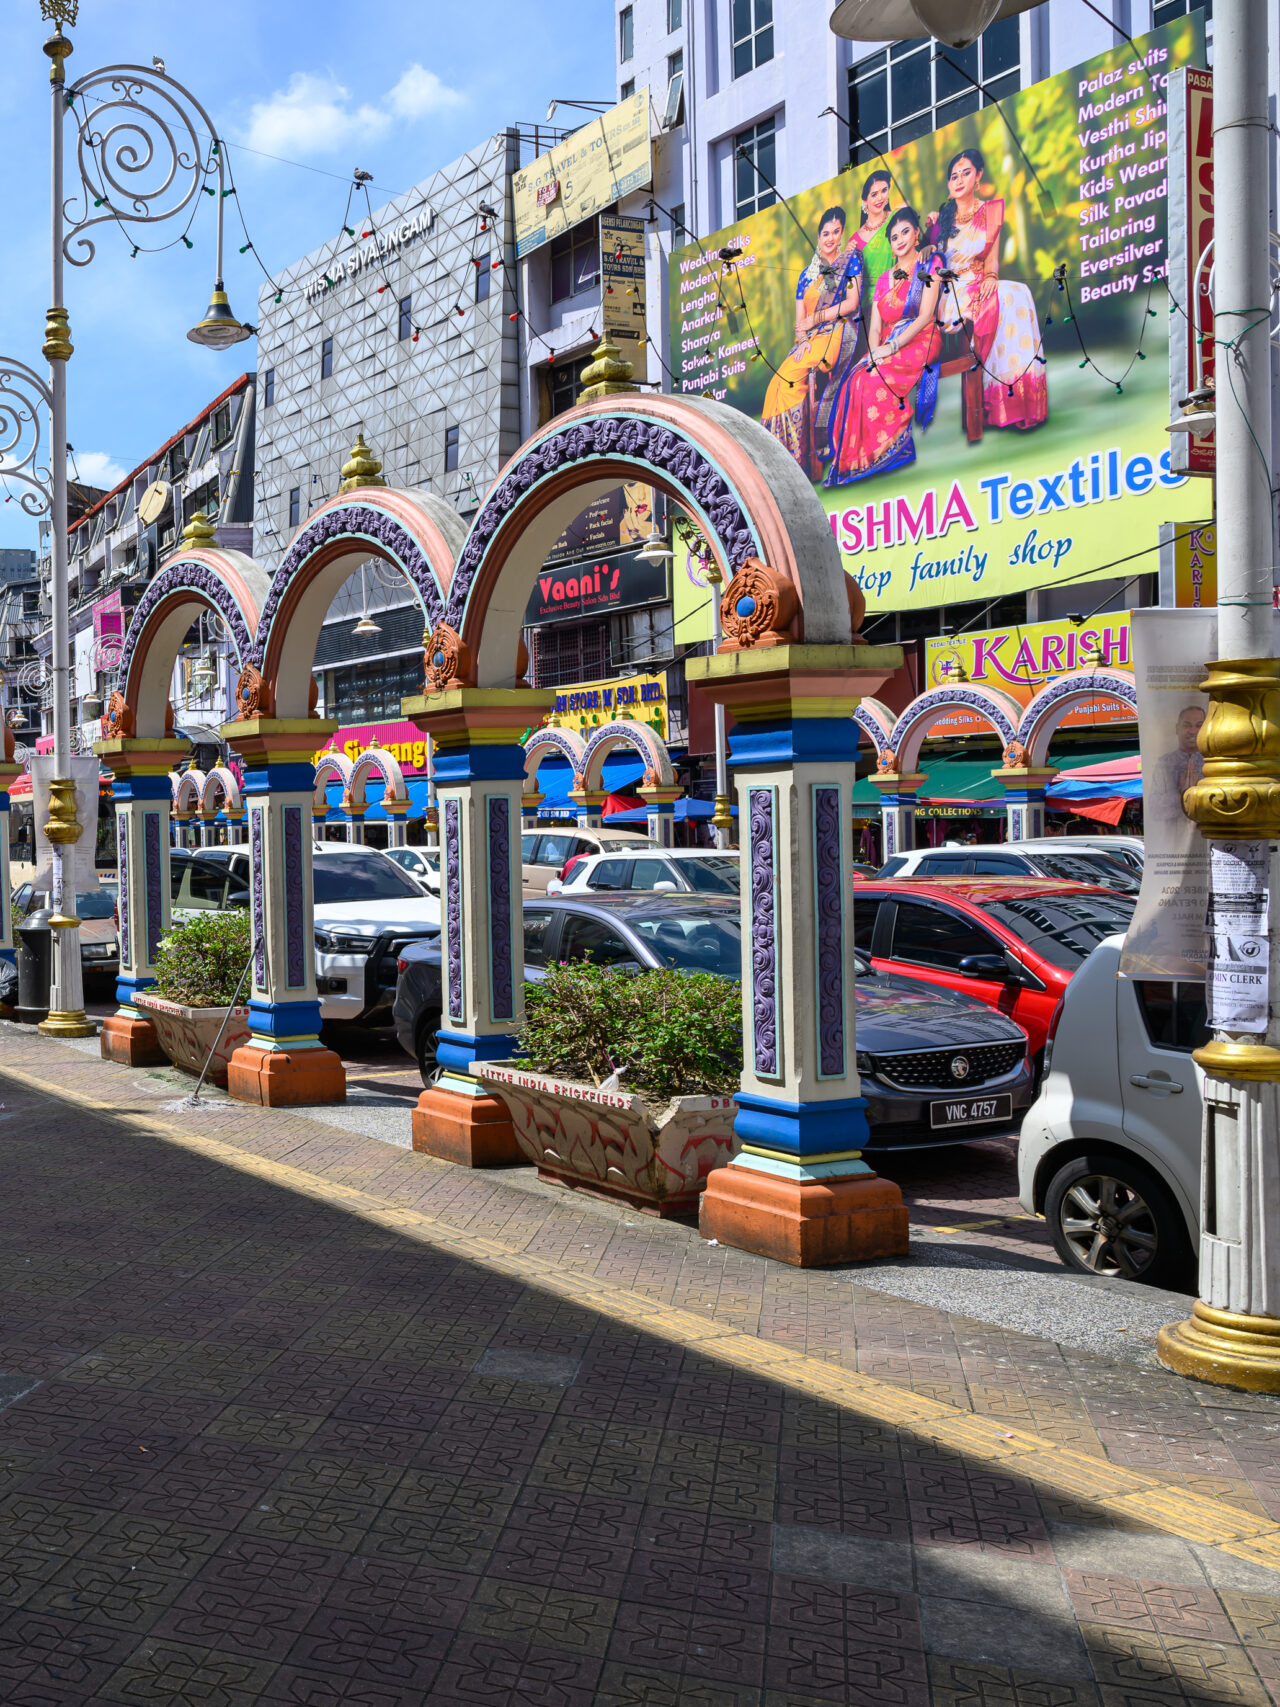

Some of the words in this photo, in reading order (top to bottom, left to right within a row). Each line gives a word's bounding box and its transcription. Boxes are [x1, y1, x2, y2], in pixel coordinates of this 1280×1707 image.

[1078, 67, 1123, 98] Palaz
[1128, 47, 1168, 75] suits
[1077, 84, 1144, 123] Modern
[1077, 114, 1130, 149] Vesthi
[544, 153, 577, 180] TRAVEL
[589, 126, 623, 152] TOURS
[1078, 142, 1136, 175] Kurtha
[1079, 176, 1115, 200] Kids
[1119, 156, 1168, 185] Wear
[1079, 201, 1110, 227] Silk
[347, 208, 434, 275] SIVALINGAM
[727, 233, 751, 250] Silks
[1079, 214, 1156, 252] Tailoring
[603, 263, 621, 272] TOURS
[616, 256, 637, 265] TRAVEL
[680, 268, 718, 295] Modern
[721, 253, 756, 277] Srees
[1080, 238, 1164, 278] Eversilver
[681, 290, 717, 314] Lengha
[1080, 273, 1139, 304] Beauty
[681, 308, 723, 334] Anarkali
[681, 329, 721, 353] Sharara
[718, 336, 760, 360] Kameez
[682, 368, 719, 393] Punjabi
[721, 360, 746, 379] Suits
[979, 447, 1188, 524] Textiles
[910, 543, 988, 592] family
[1008, 528, 1074, 569] shop
[540, 564, 620, 603] Vaani's
[540, 605, 562, 615] Exclusive
[563, 601, 580, 610] Beauty
[581, 597, 597, 606] Salon
[598, 593, 608, 602] Sdn
[609, 591, 620, 600] Bhd
[970, 625, 1130, 684] KARISH
[570, 690, 599, 711] STORE
[640, 682, 664, 702] BHD.
[1074, 702, 1101, 714] Punjabi
[1101, 701, 1120, 712] Suits
[958, 714, 974, 725] Silks
[928, 807, 982, 816] COLLECTIONS
[1229, 974, 1262, 984] CLERK
[480, 1067, 513, 1084] LITTLE
[518, 1076, 548, 1092] INDIA
[554, 1082, 632, 1110] BRICKFIELDS
[946, 1104, 967, 1120] VNC
[970, 1100, 997, 1117] 4757
